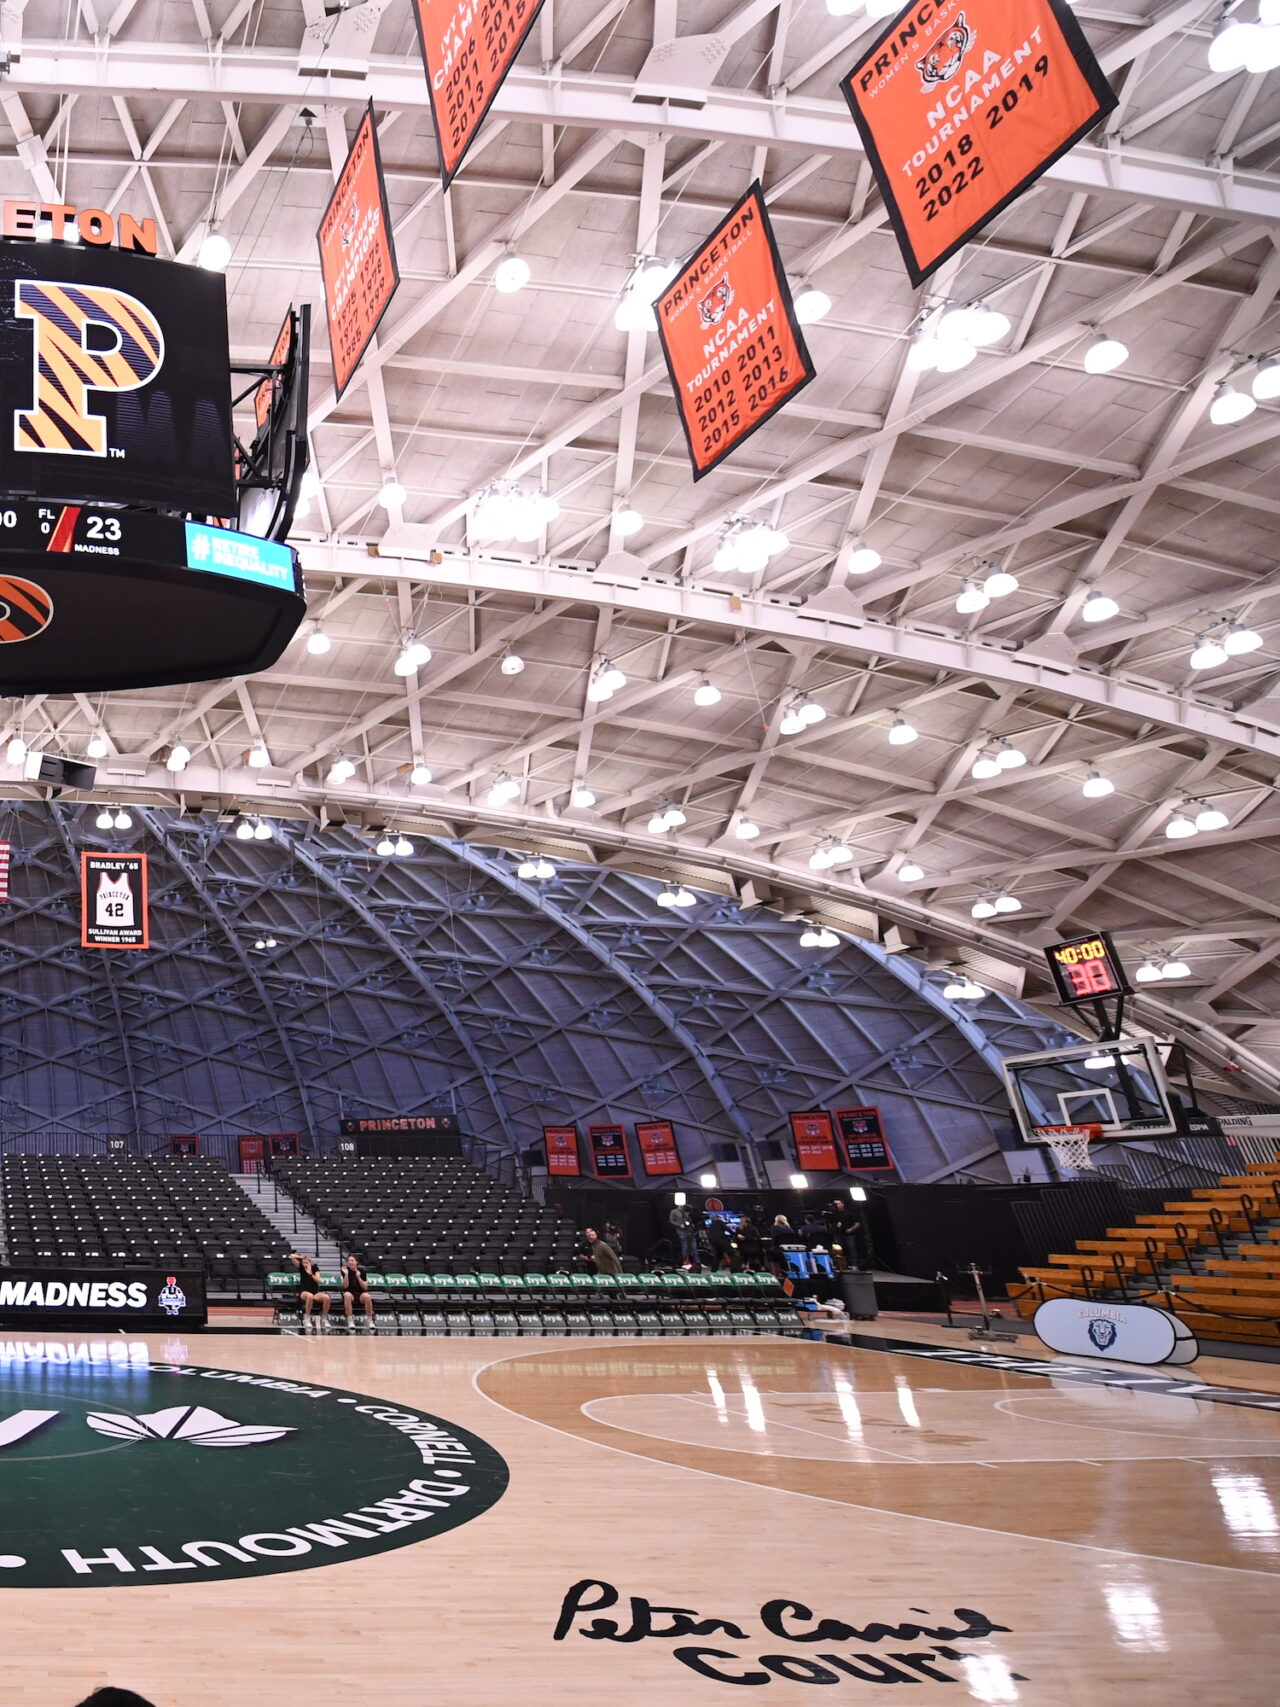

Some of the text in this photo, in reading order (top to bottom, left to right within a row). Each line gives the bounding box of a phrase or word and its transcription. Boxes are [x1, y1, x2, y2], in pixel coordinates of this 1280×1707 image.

[446, 36, 476, 103] 2006
[448, 58, 479, 126] 2011
[452, 80, 484, 149] 2013
[490, 1, 526, 72] 2015
[869, 41, 920, 98] WOMEN'S
[926, 49, 1002, 129] NCAA
[901, 25, 1043, 177] TOURNAMENT
[915, 55, 1049, 200] 2018 2019
[322, 126, 369, 244] PRINCETON
[923, 156, 985, 222] 2022
[664, 207, 754, 318] PRINCETON
[702, 229, 753, 290] BASKETBALL
[337, 288, 356, 332] 1975
[339, 308, 359, 350] 1977
[702, 307, 750, 359] NCAA
[14, 279, 165, 457] P
[686, 299, 776, 394] TOURNAMENT
[694, 325, 776, 413] 2010 2011
[698, 345, 783, 433] 2012 2013
[704, 366, 789, 453] 2015 2016
[38, 509, 56, 520] FL
[86, 516, 122, 540] 23
[41, 522, 50, 534] 0
[74, 543, 120, 556] MADNESS
[105, 903, 124, 917] 42
[1054, 940, 1105, 964] 40:00
[1067, 959, 1111, 996] 30
[110, 1139, 124, 1149] 107
[340, 1141, 354, 1151] 108
[359, 1117, 436, 1132] PRINCETON
[0, 1281, 148, 1308] MADNESS
[1076, 1307, 1127, 1324] COLUMBIA
[355, 1404, 477, 1465] CORNELL
[60, 1479, 470, 1574] DARTMOUTH
